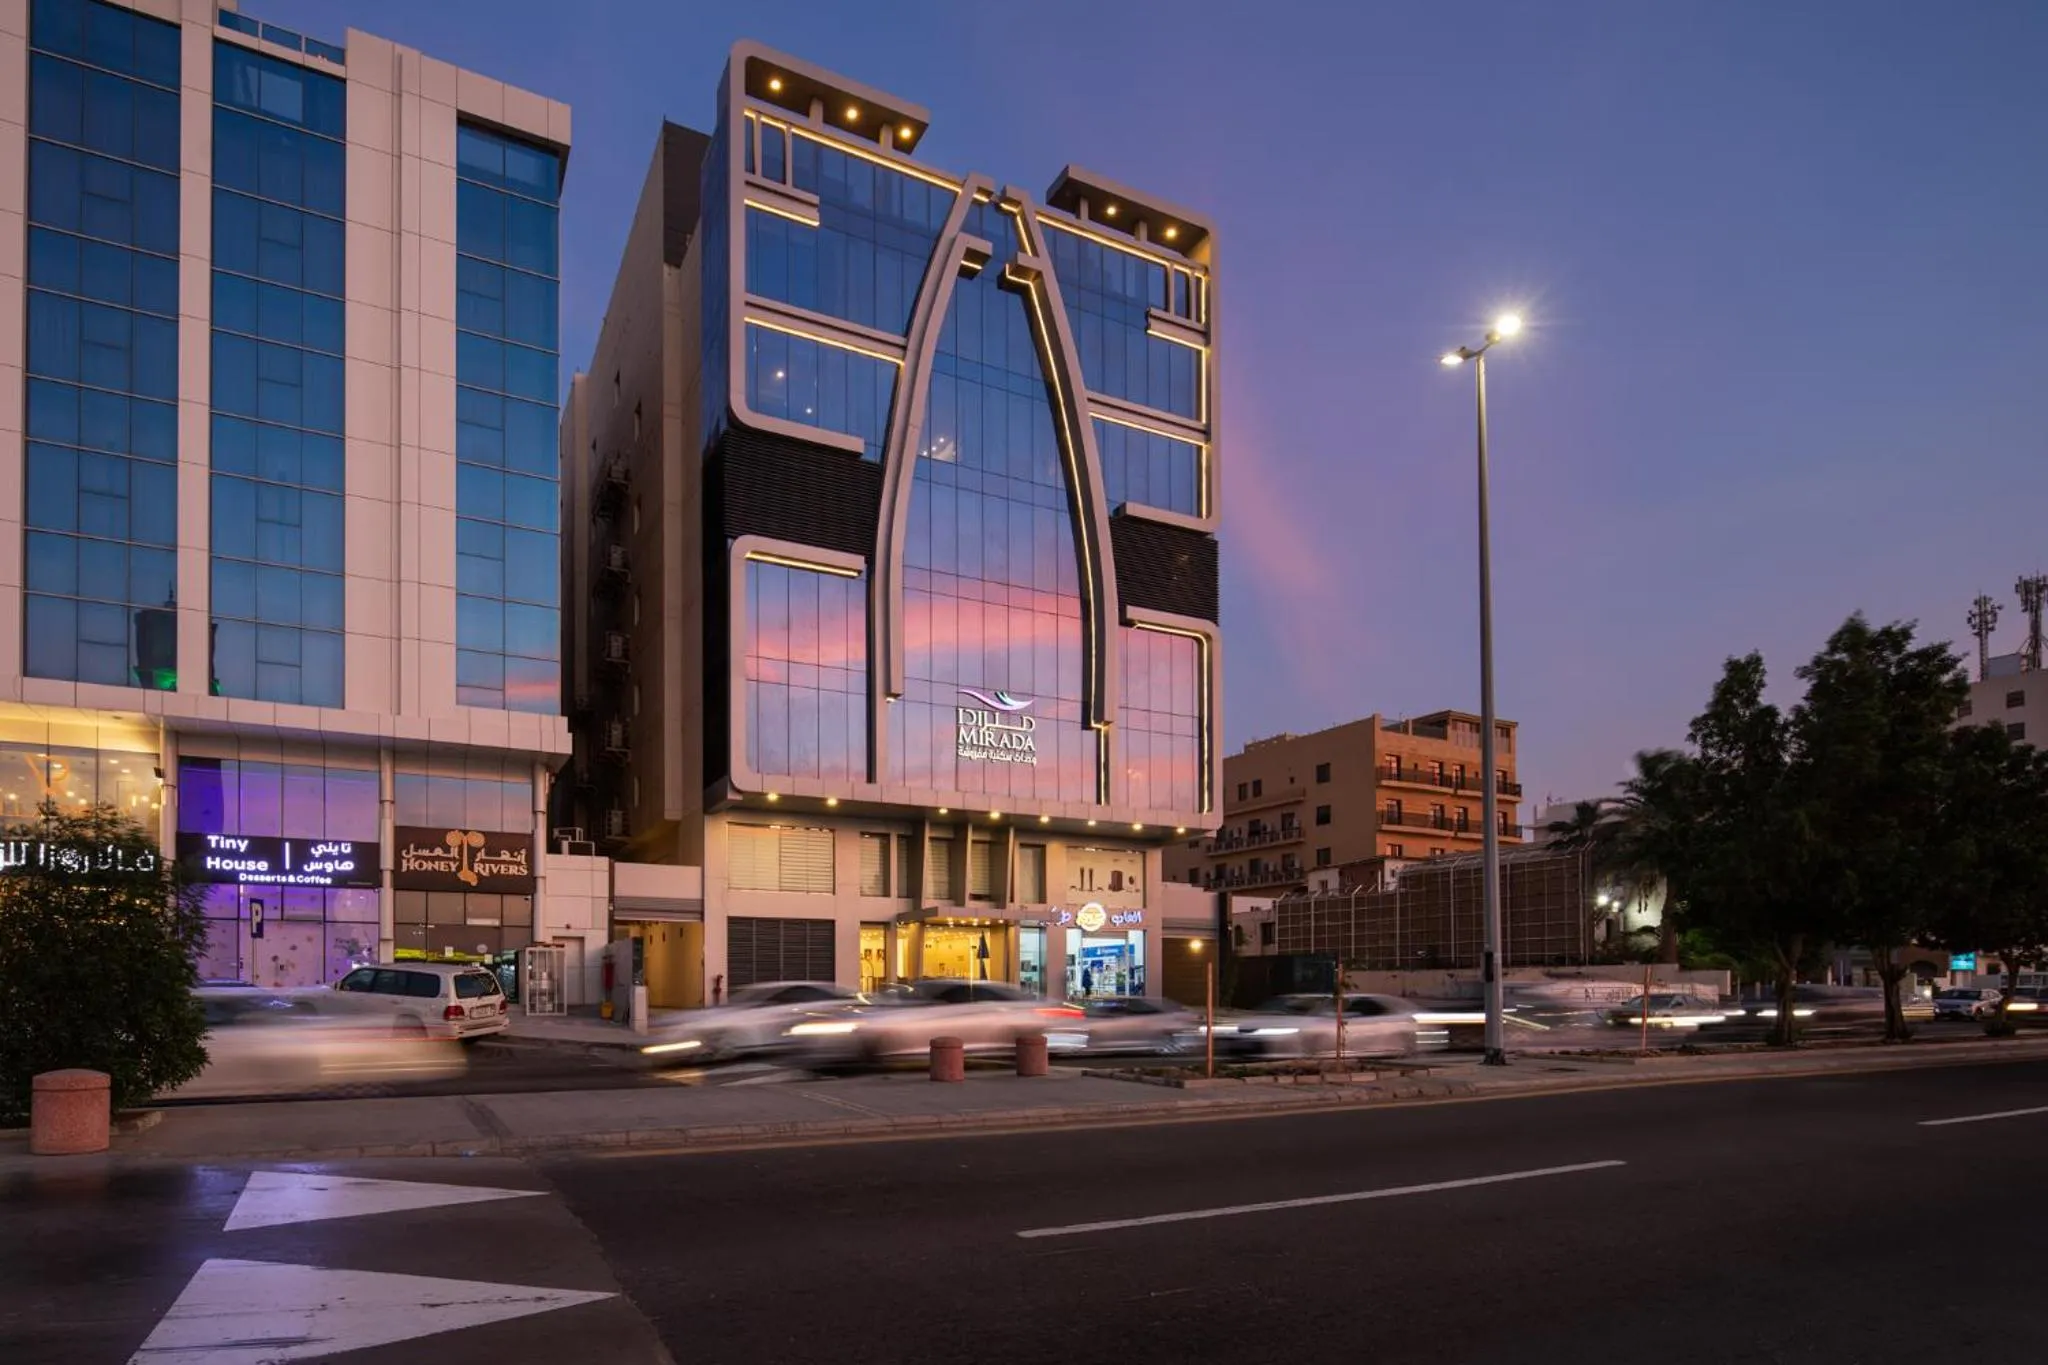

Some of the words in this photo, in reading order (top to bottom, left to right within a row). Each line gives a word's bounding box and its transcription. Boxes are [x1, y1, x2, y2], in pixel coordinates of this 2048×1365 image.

[958, 726, 1037, 752] MIRADA
[207, 835, 249, 853] Tiny
[310, 842, 351, 858] تايني
[401, 843, 460, 860] العسل
[206, 856, 269, 872] House
[303, 860, 355, 873] هاوس
[401, 858, 460, 873] HONEY
[473, 862, 528, 877] RIVERS
[296, 875, 333, 885] Coffee
[251, 902, 263, 934] P
